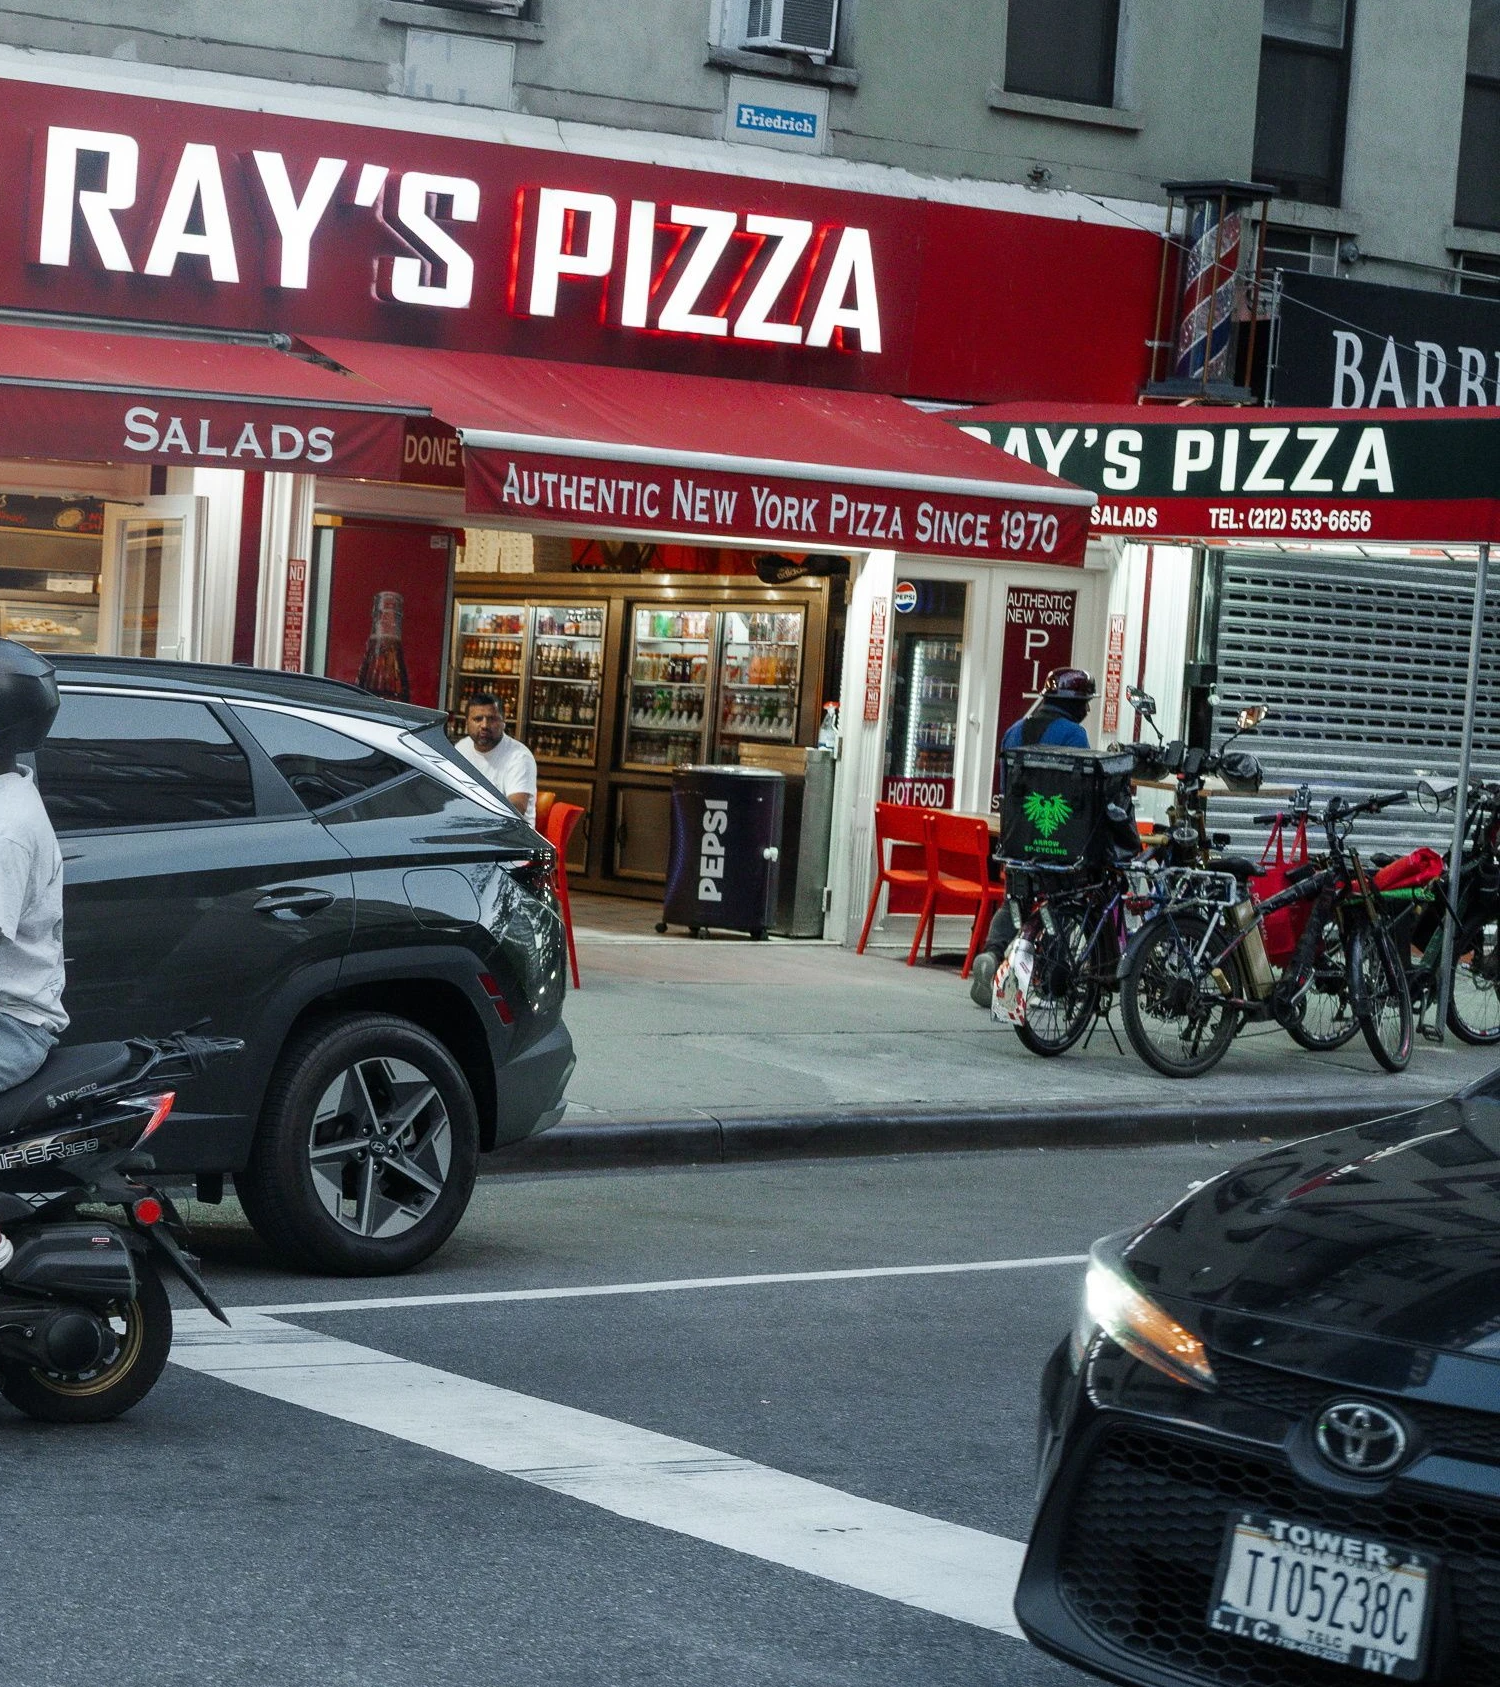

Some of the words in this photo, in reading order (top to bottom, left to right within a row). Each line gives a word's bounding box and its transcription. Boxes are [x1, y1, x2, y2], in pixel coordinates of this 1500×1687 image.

[740, 108, 813, 133] Friedrich
[39, 126, 480, 309] RAY'S
[529, 189, 881, 354] PIZZA
[1331, 330, 1500, 408] BARB
[124, 406, 334, 463] SALADS
[404, 434, 457, 467] DONE
[1172, 427, 1394, 493] PIZZA
[503, 462, 660, 518] AUTHENTIC
[672, 479, 738, 524] NEW
[750, 486, 819, 532] YORK
[829, 493, 904, 540] PIZZA
[916, 502, 990, 547] SINCE
[1000, 511, 1058, 553] 1970
[1090, 505, 1158, 528] SALADS
[1209, 508, 1244, 530] TEL:
[1248, 508, 1286, 530] (212)
[1291, 509, 1372, 533] 533-6656
[1006, 592, 1072, 610] AUTHENTIC
[1006, 610, 1034, 623] NEW
[1040, 611, 1070, 626] YORK
[888, 782, 912, 807] HOT
[913, 783, 945, 808] FOOD
[698, 799, 729, 902] PEPSI
[1246, 1549, 1414, 1645] T105238C
